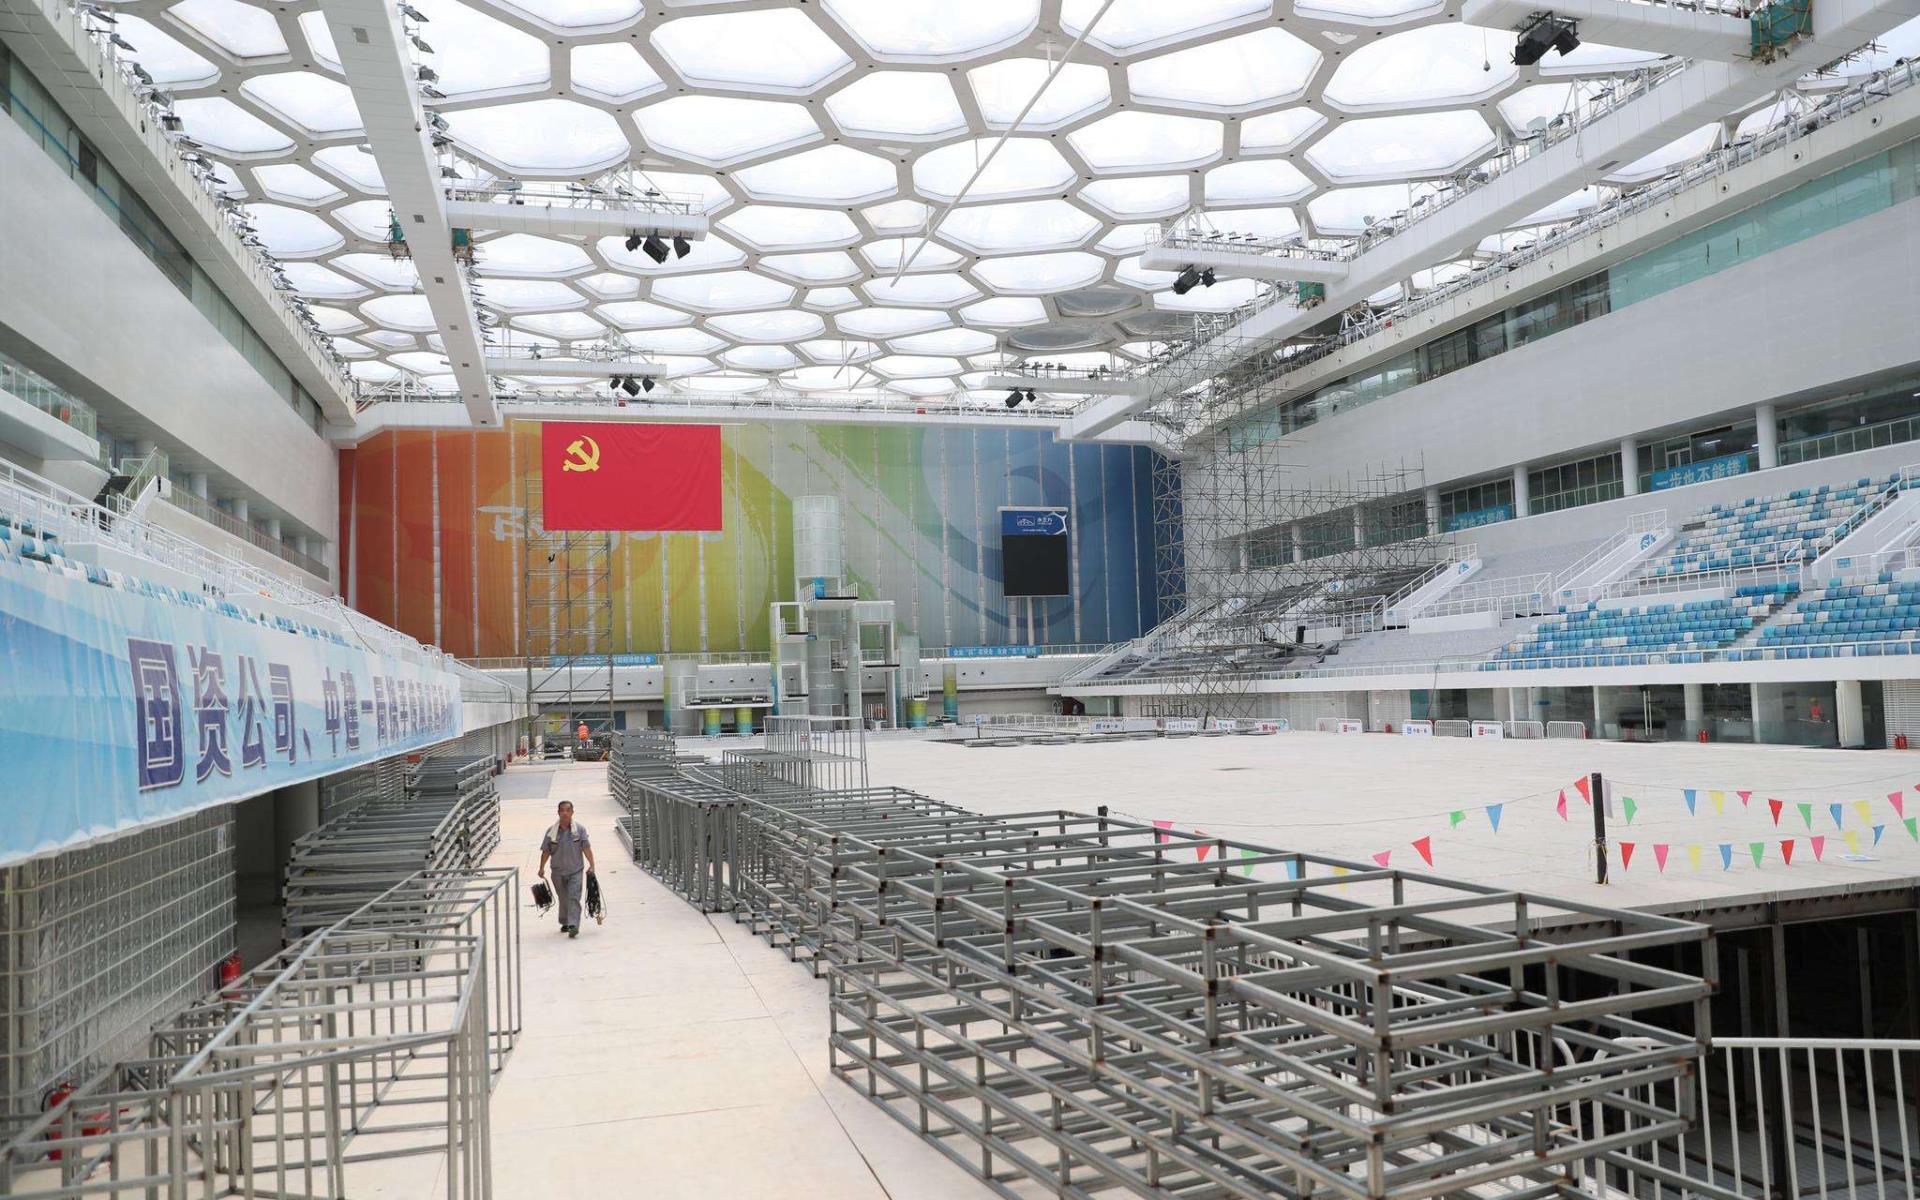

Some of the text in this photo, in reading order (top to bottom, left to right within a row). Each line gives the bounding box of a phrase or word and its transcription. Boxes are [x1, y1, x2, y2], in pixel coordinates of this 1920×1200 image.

[1656, 459, 1741, 487] 一步也不能错
